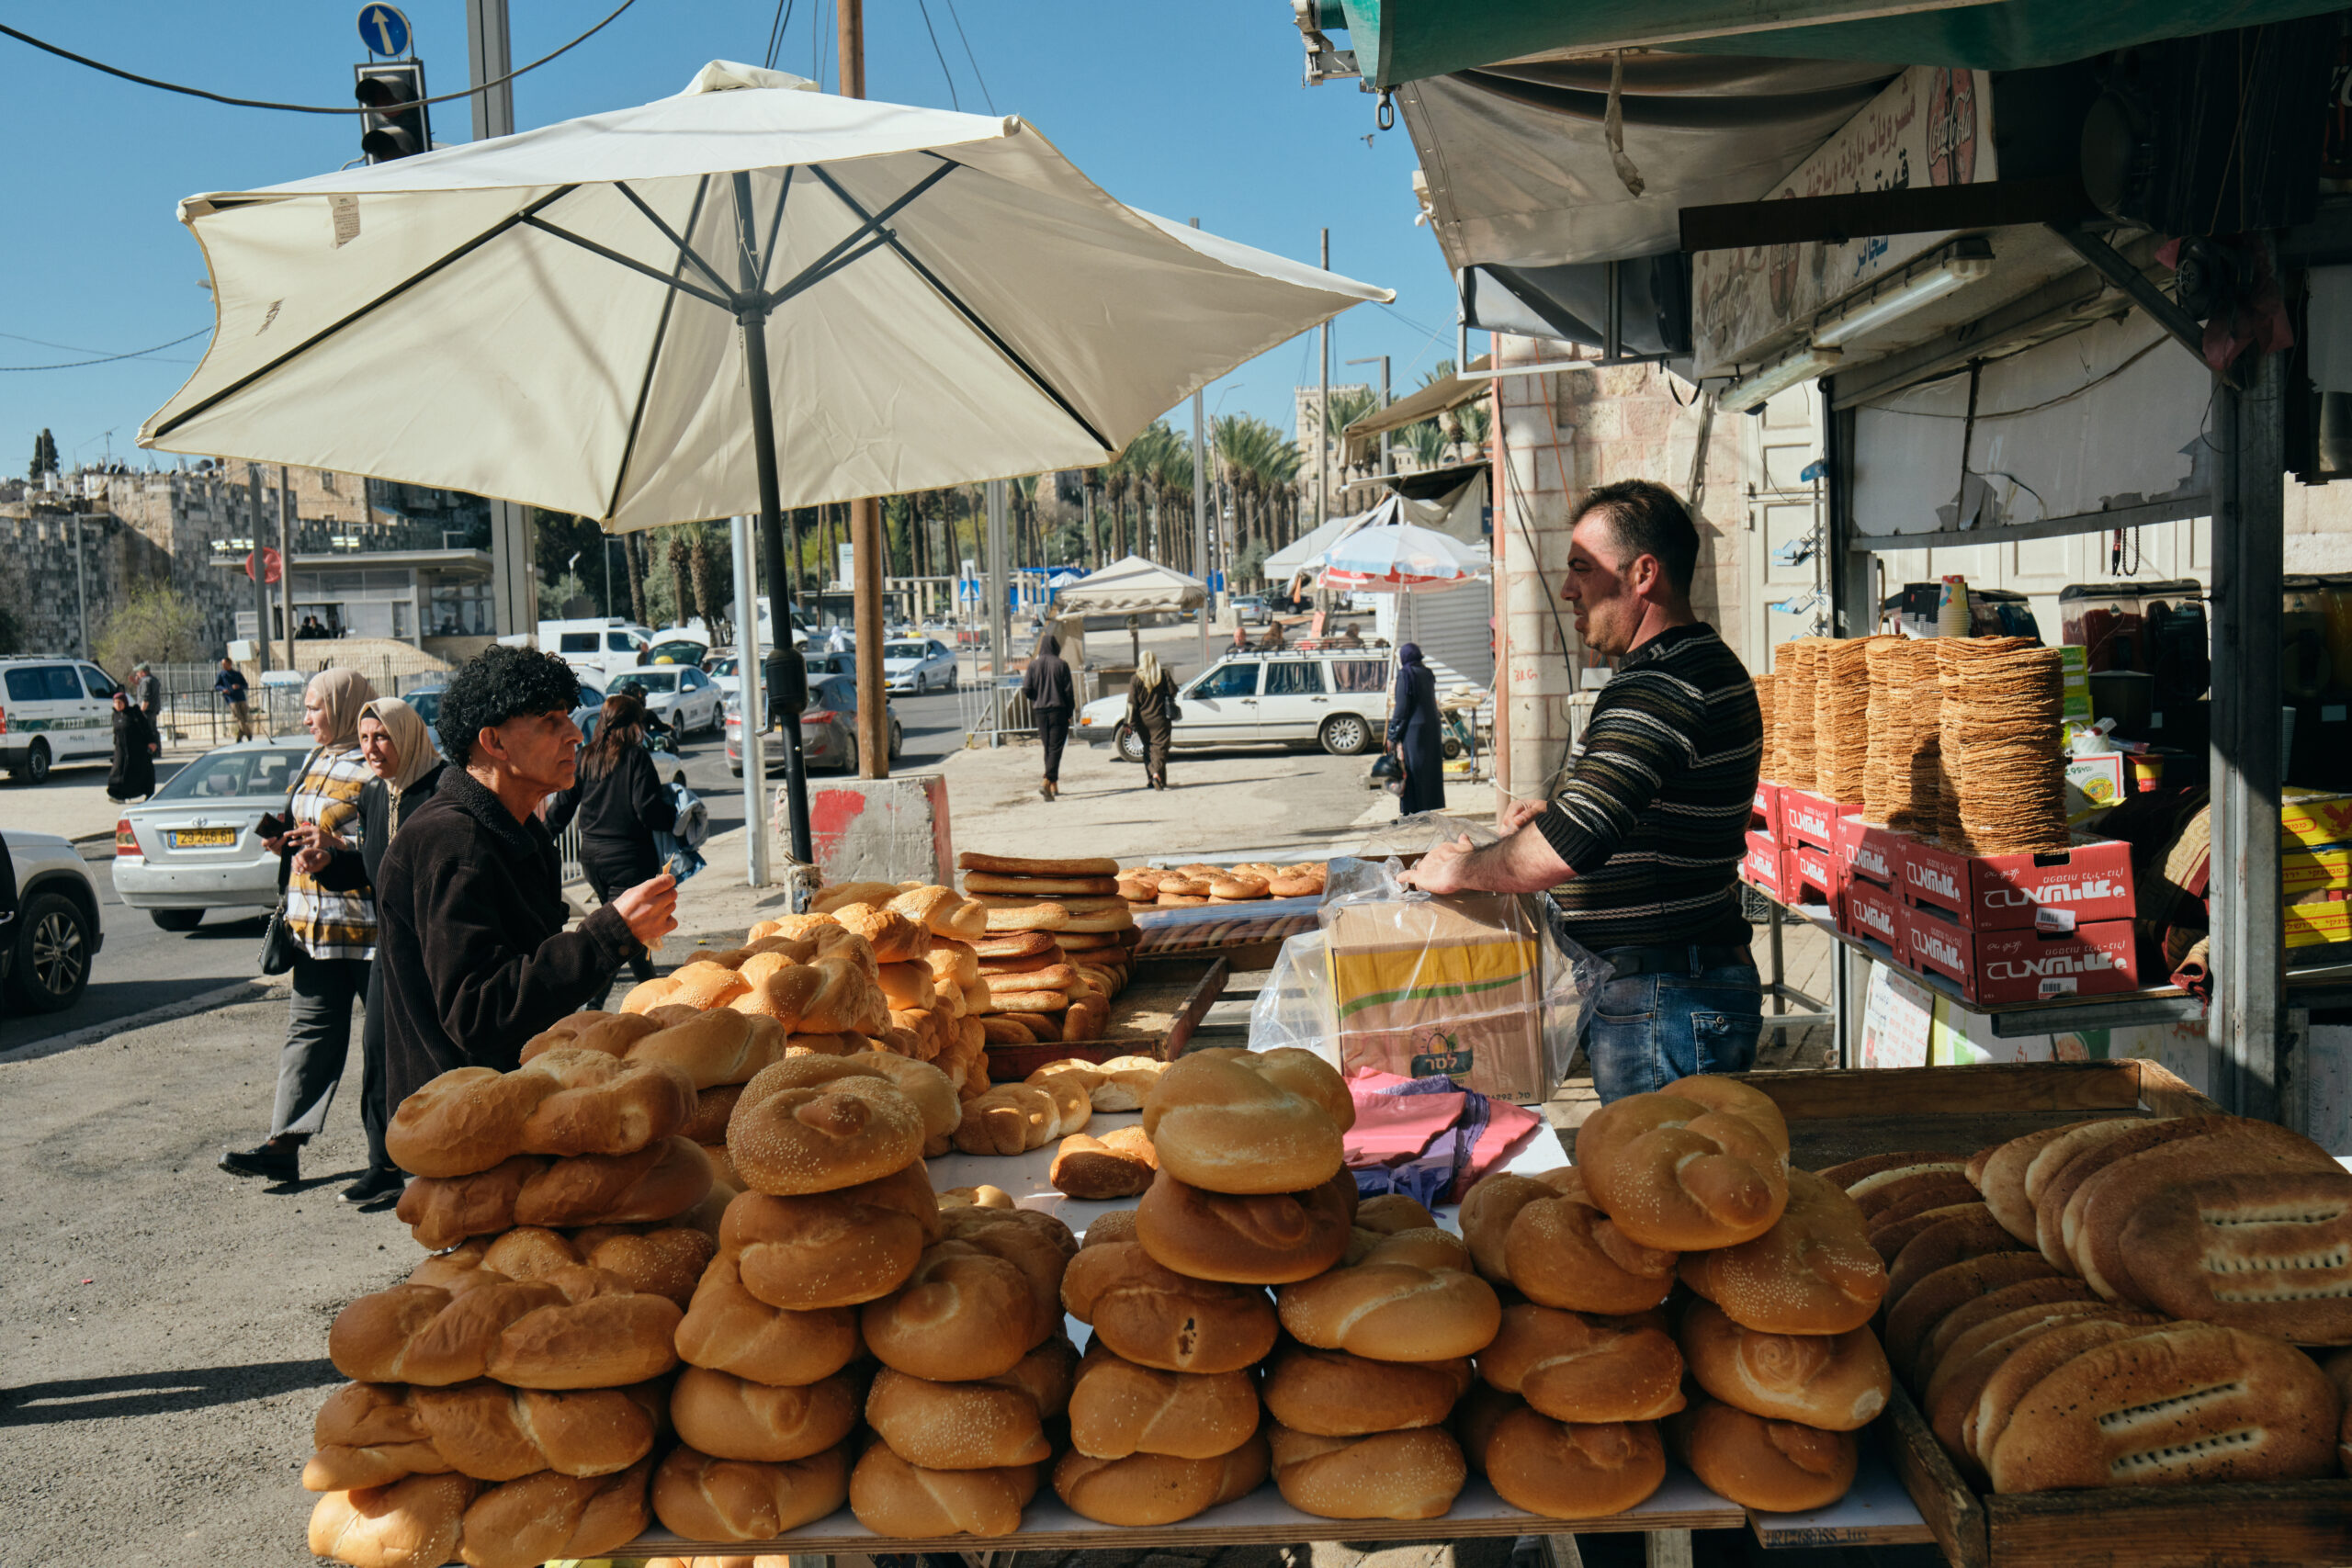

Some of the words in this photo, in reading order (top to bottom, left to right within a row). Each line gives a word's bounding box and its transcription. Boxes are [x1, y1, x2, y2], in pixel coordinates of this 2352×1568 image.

[1788, 807, 1826, 840] בראשית
[1846, 843, 1884, 875] בראשית
[1905, 861, 1955, 898] בראשית
[1984, 879, 2112, 908] בראשית
[1852, 898, 1890, 935] בראשית
[1911, 927, 1959, 971] בראשית
[1986, 951, 2113, 980] בראשית
